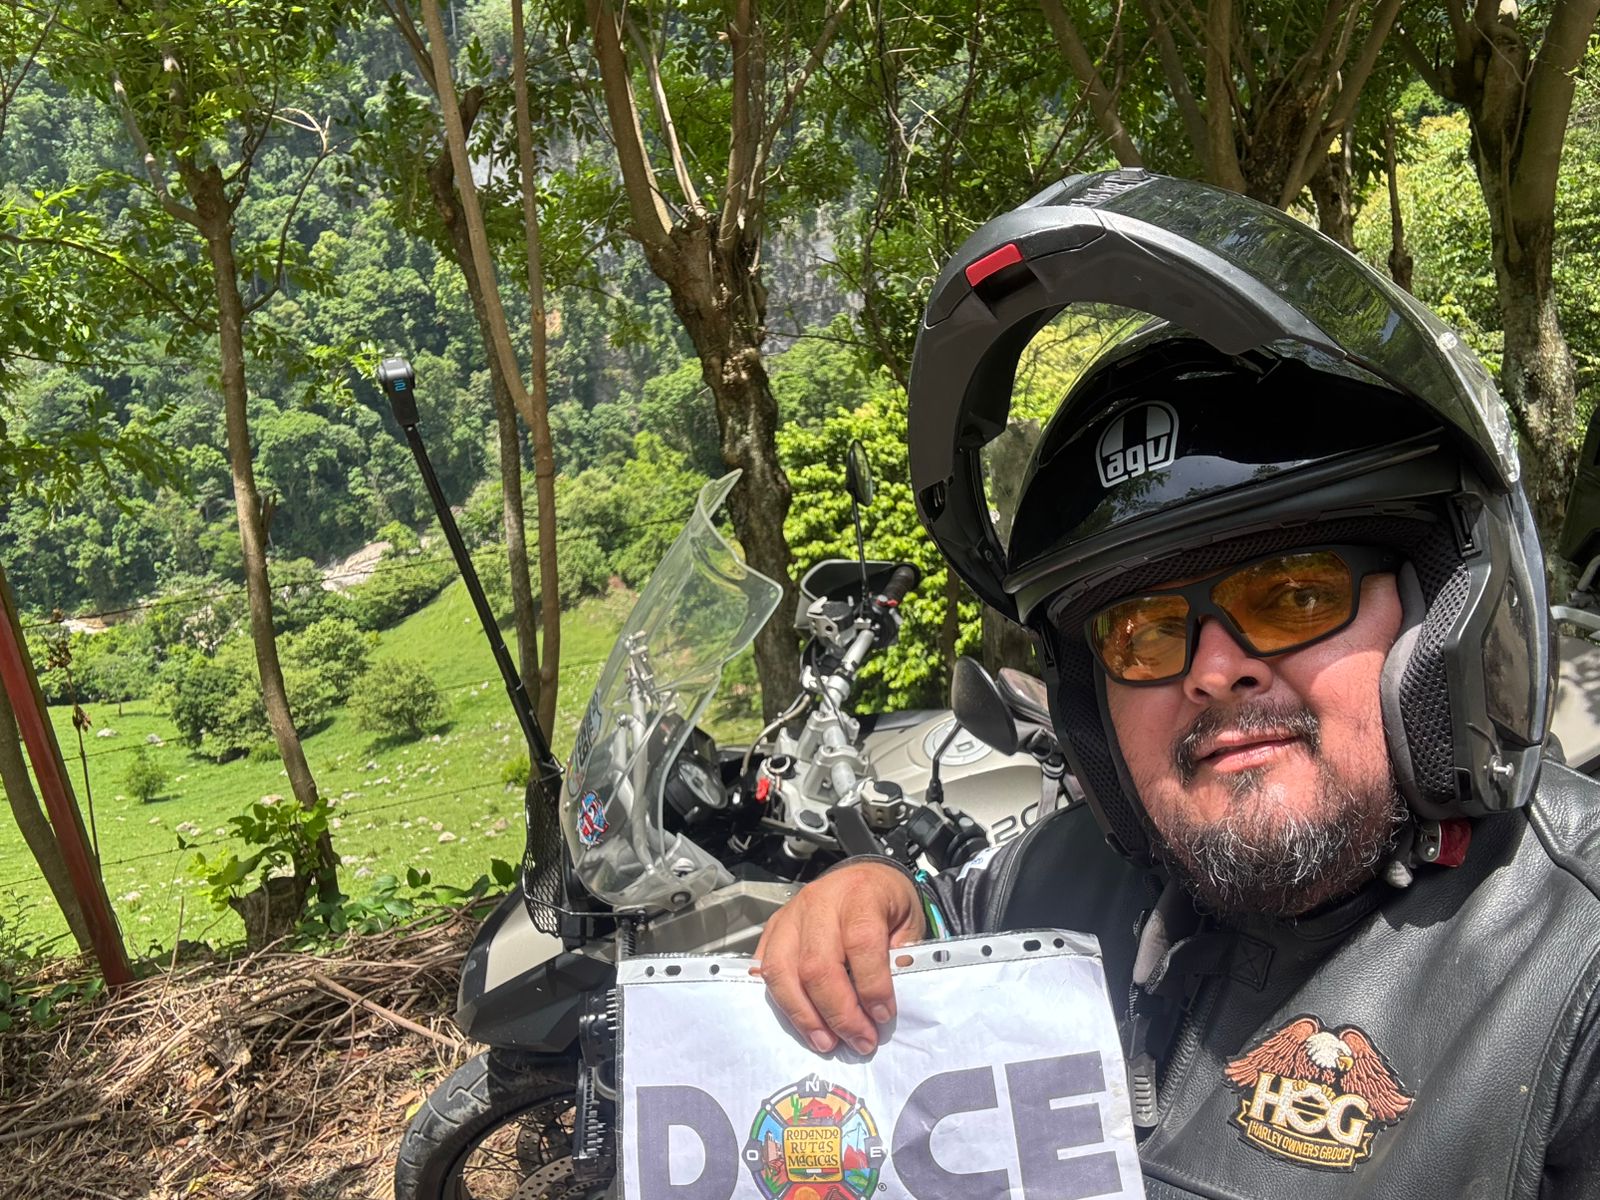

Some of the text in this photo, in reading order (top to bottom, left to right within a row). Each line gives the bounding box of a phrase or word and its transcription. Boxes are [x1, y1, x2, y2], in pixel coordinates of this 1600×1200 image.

[1106, 435, 1169, 480] agv
[1248, 1071, 1370, 1147] HOG
[1250, 1121, 1351, 1161] HARLEY OWNERS GROUP
